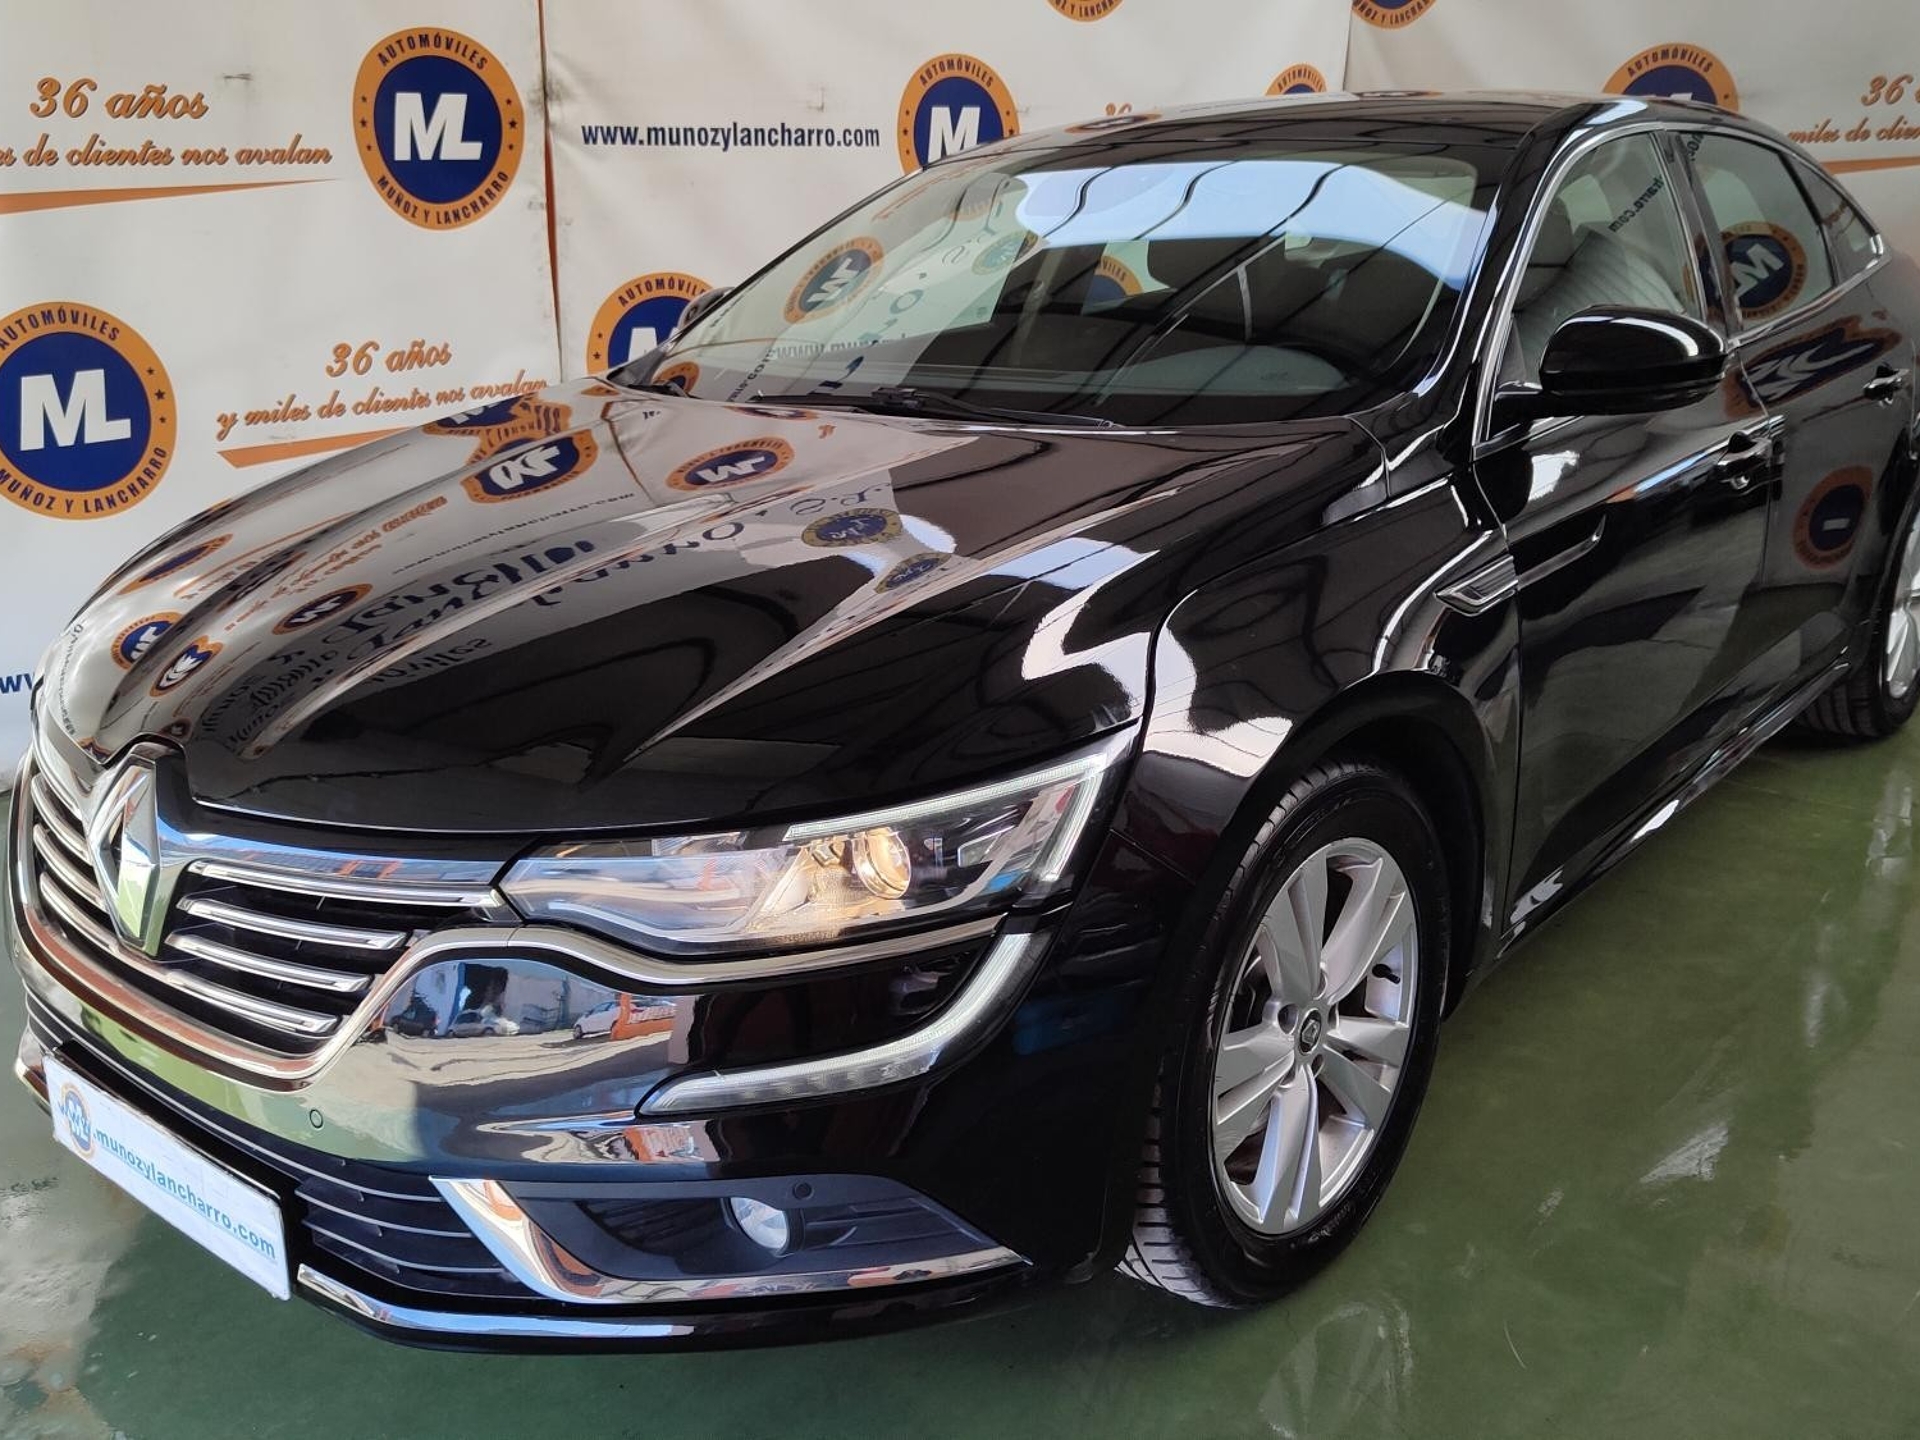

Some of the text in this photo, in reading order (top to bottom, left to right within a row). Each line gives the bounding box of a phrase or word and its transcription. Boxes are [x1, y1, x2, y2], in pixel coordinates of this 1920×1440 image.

[377, 31, 489, 70] AUTOMÓVILES
[29, 77, 209, 119] 36 años
[1861, 75, 1914, 106] 36
[394, 91, 483, 162] ML
[581, 121, 880, 153] www.munozylancharro.com
[927, 106, 981, 163] M
[1845, 117, 1871, 142] de
[22, 132, 60, 167] de
[66, 132, 175, 166] clientes
[181, 147, 229, 166] nos
[234, 133, 333, 165] avalan
[436, 171, 509, 225] LANCHARRO
[618, 276, 706, 307] AUTOMÓVIL
[325, 338, 452, 378] 36 años
[20, 368, 131, 452] ML
[216, 369, 548, 441] y miles de clientes nos avalan
[65, 498, 74, 513] Y
[83, 446, 167, 514] LANCHARRO
